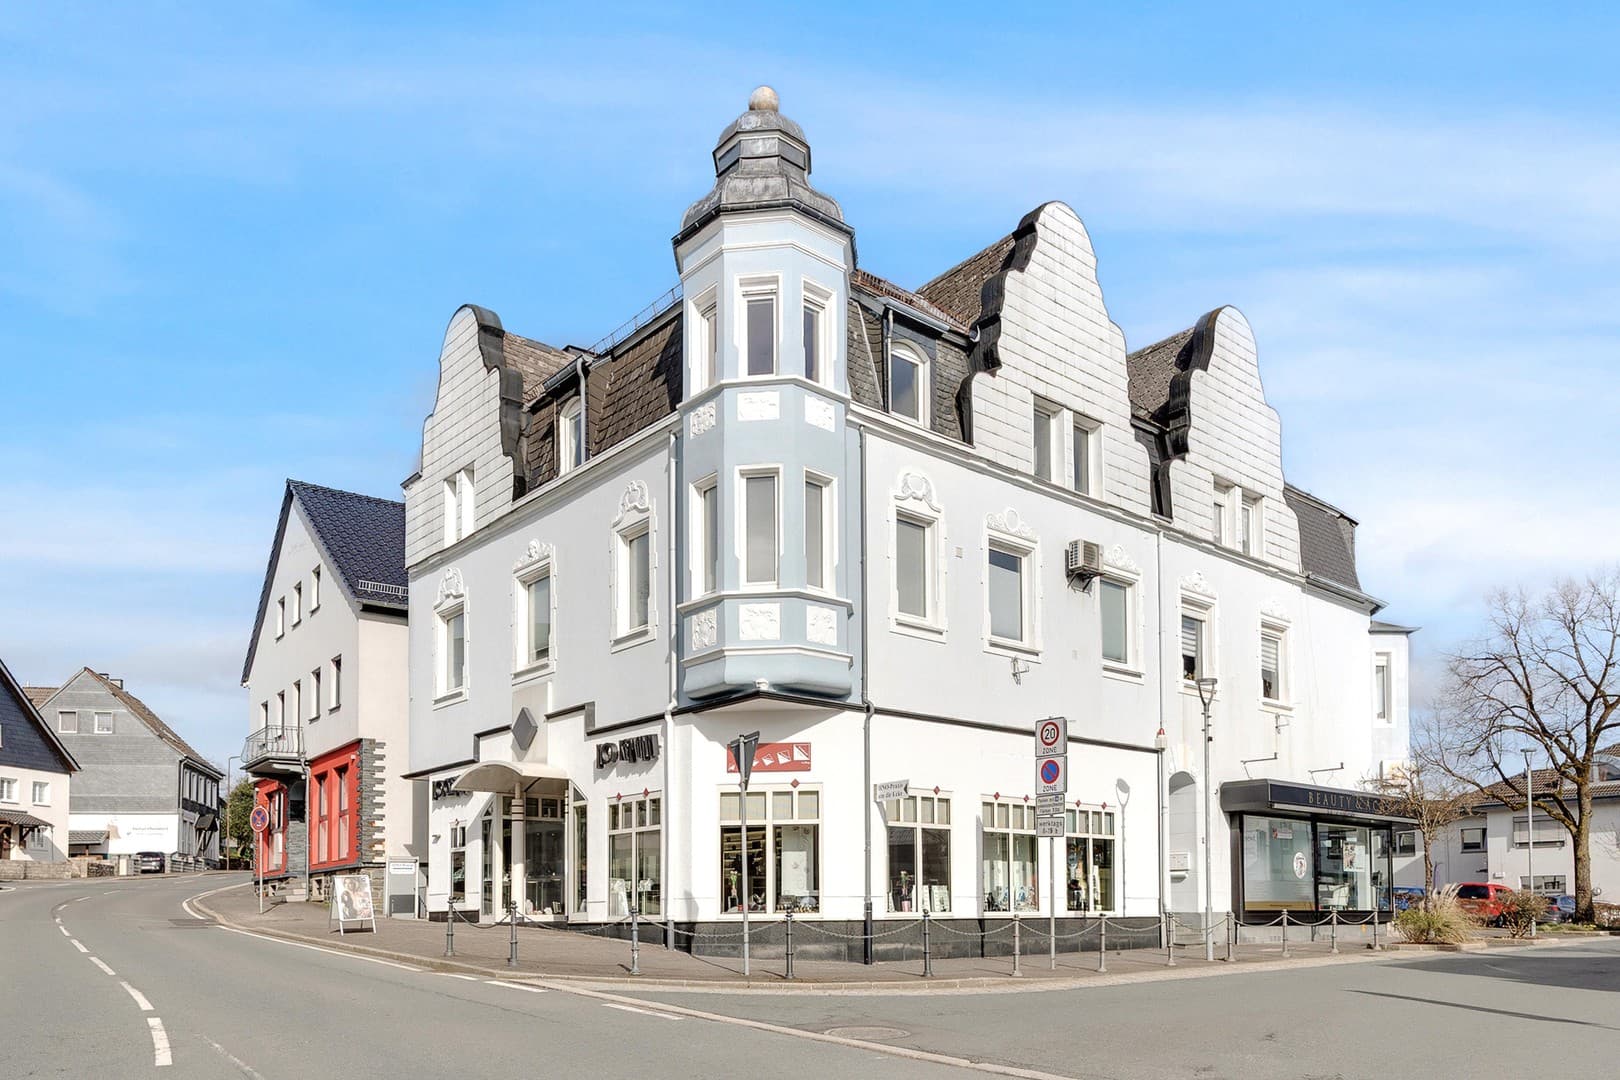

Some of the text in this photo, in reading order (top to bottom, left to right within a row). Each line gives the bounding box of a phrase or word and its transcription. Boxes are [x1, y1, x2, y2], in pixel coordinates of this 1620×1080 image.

[1044, 728, 1056, 740] 20
[1042, 746, 1057, 754] ZONE
[1042, 784, 1057, 792] ZONE
[1308, 791, 1352, 809] BEAUTY
